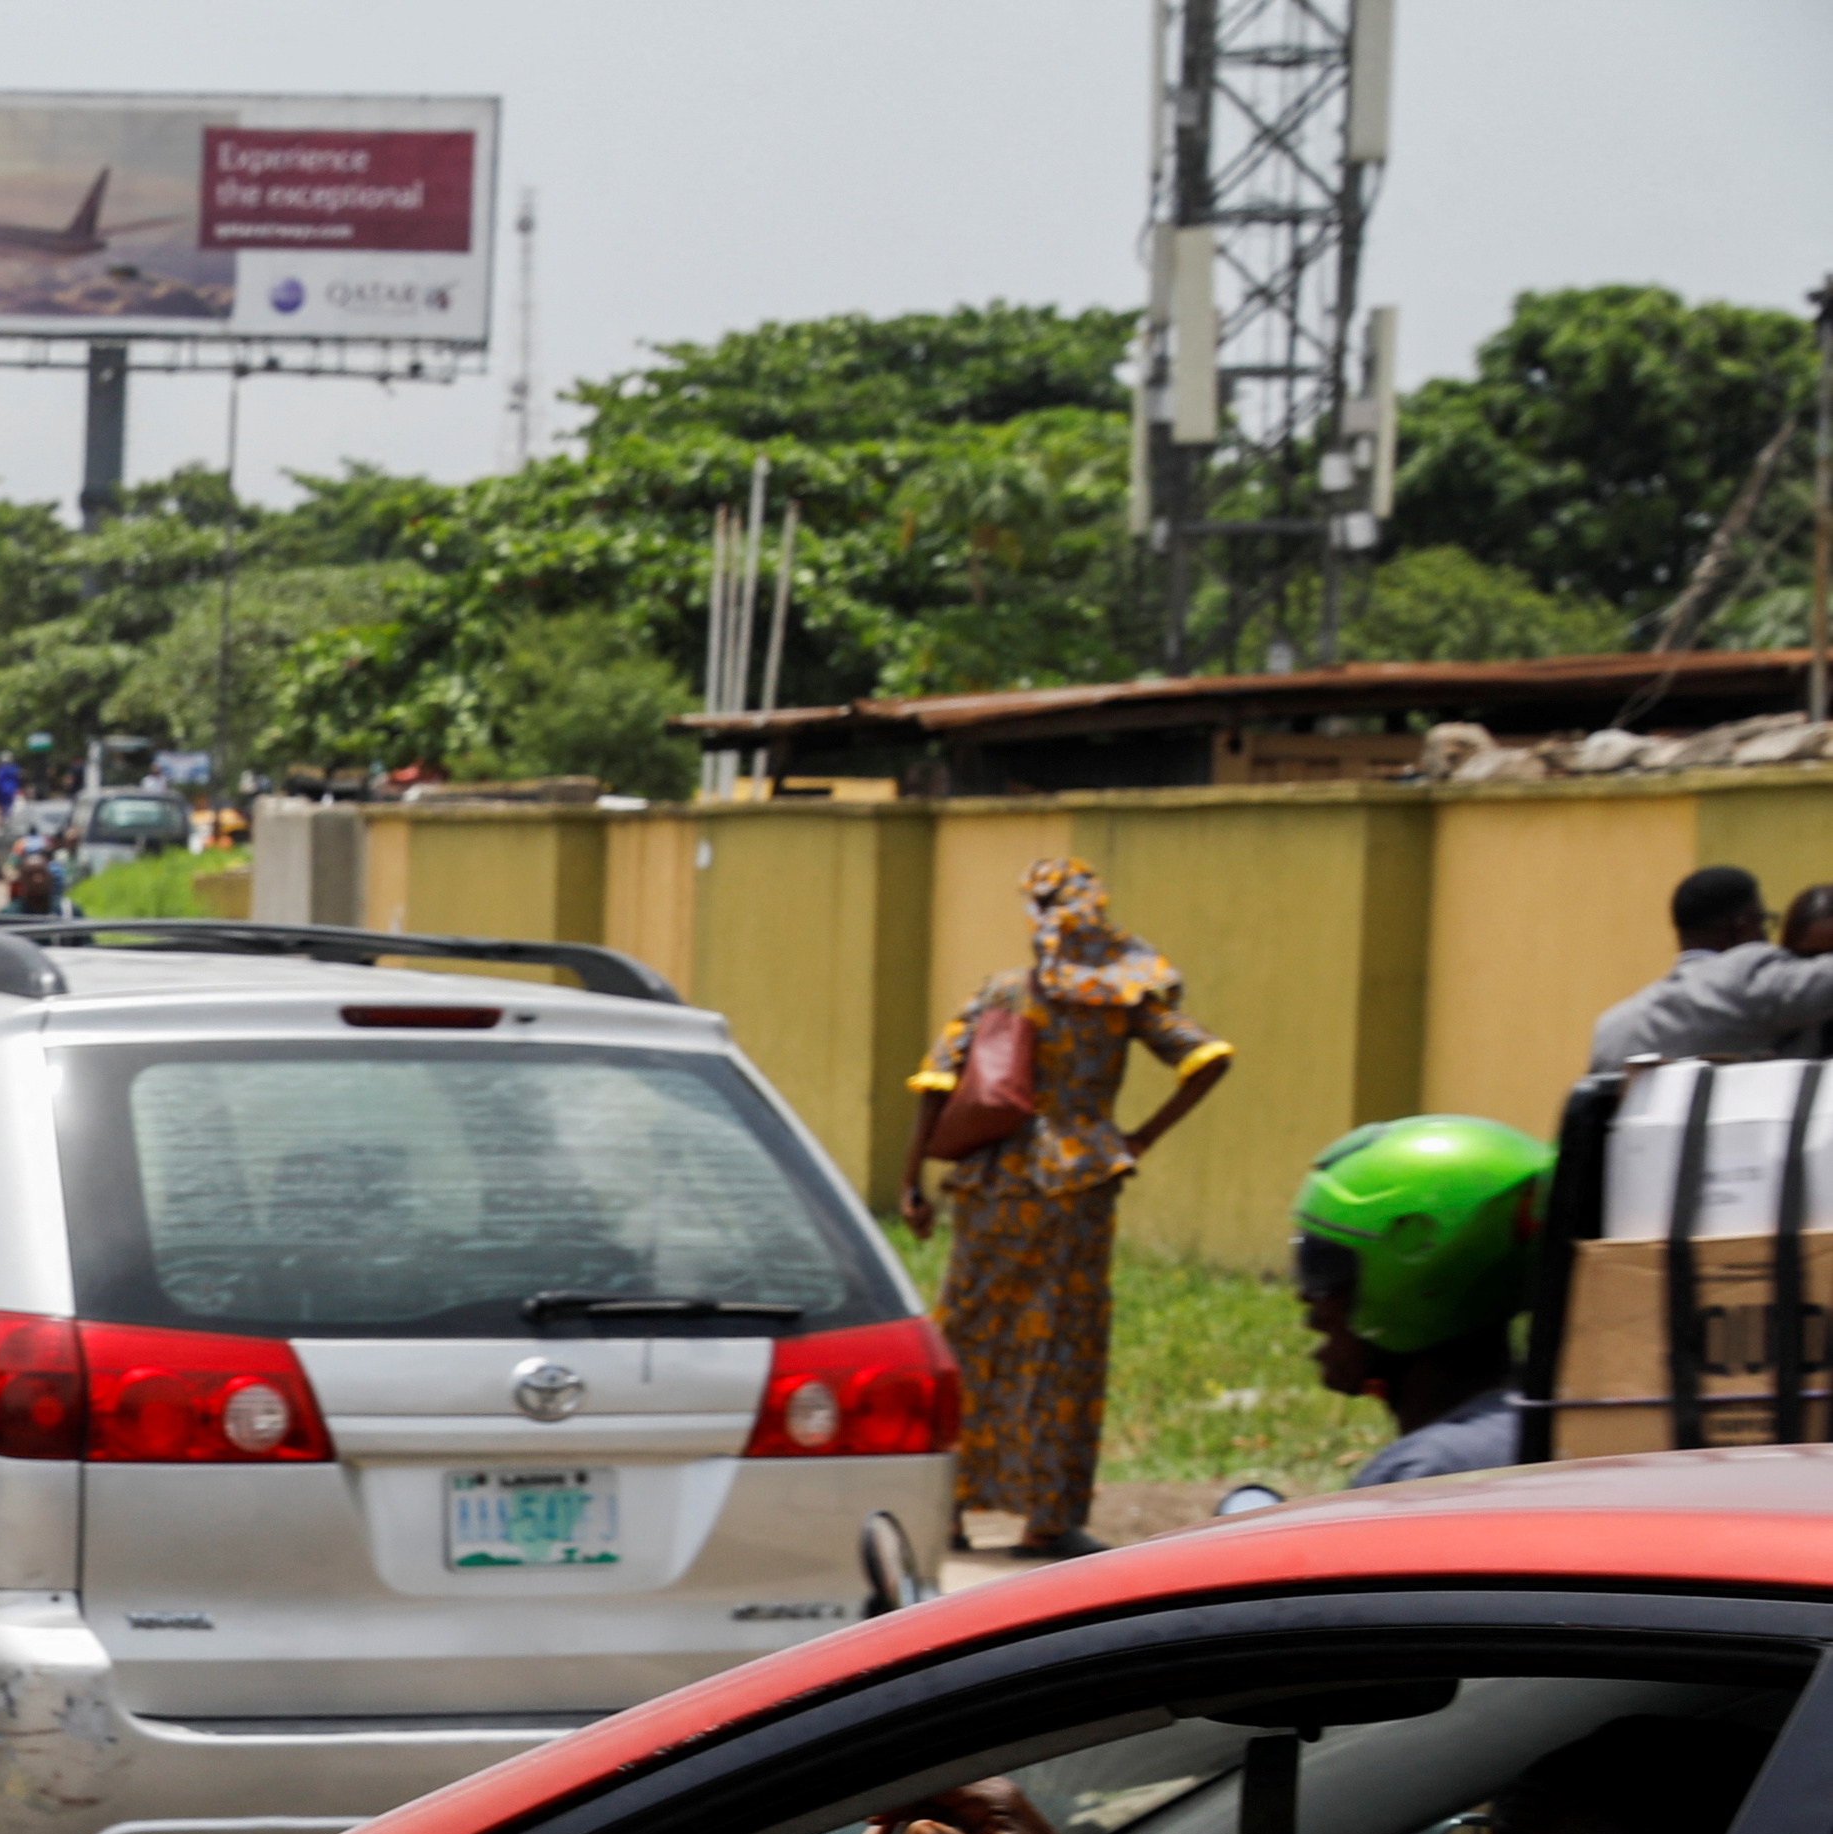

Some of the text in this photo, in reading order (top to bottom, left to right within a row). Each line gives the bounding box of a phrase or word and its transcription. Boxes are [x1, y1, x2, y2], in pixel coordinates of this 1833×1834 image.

[217, 142, 370, 177] Experience
[215, 177, 425, 214] the exceptional
